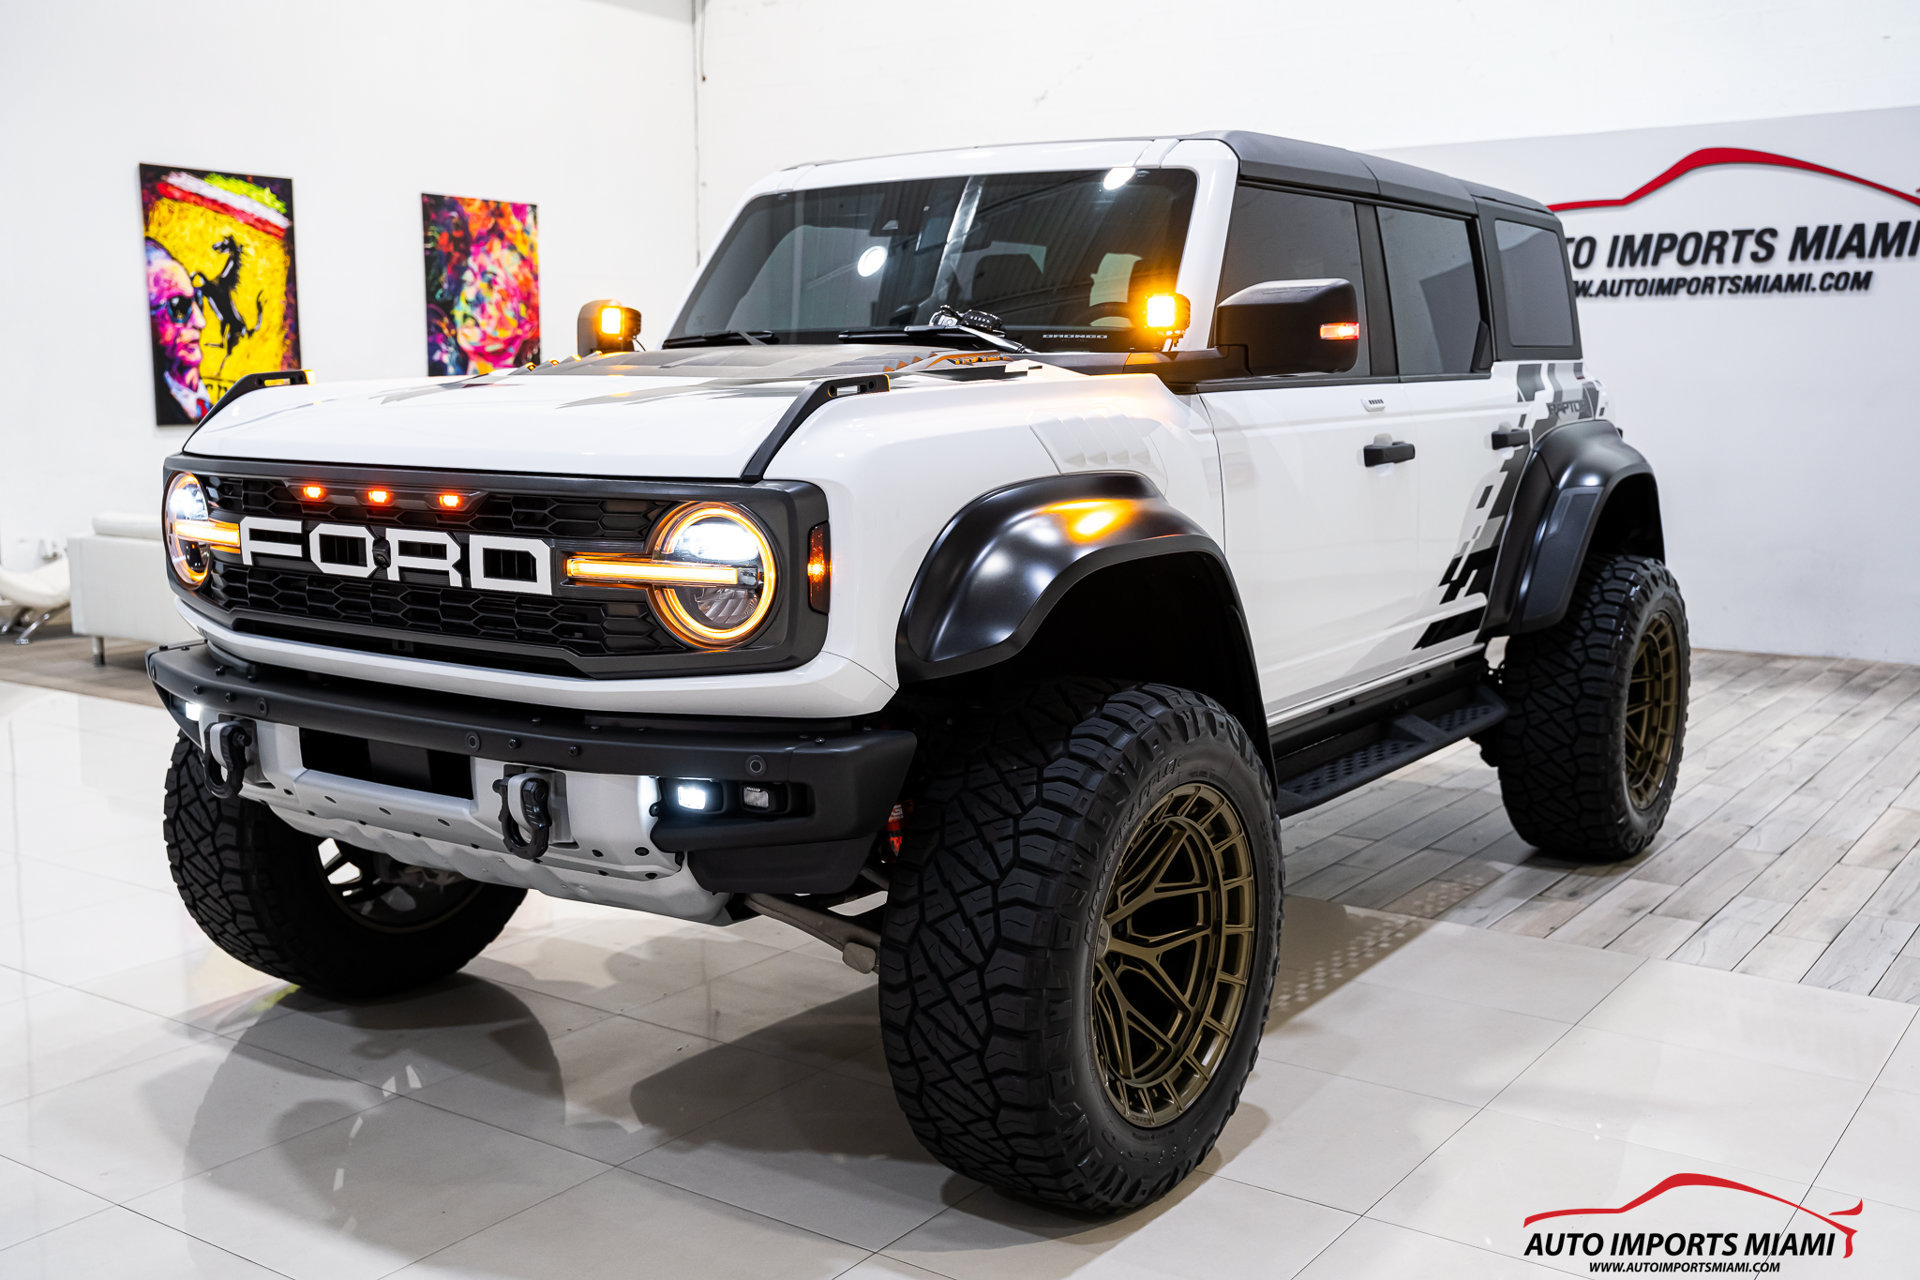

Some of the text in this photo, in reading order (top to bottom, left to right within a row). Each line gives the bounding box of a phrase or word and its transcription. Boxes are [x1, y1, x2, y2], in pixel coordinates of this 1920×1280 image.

[1606, 227, 1779, 268] IMPORTS
[1788, 220, 1920, 262] MIAMI
[1573, 271, 1873, 298] W.AUTOIMPORTSMIAMI.COM
[240, 516, 552, 595] FORD
